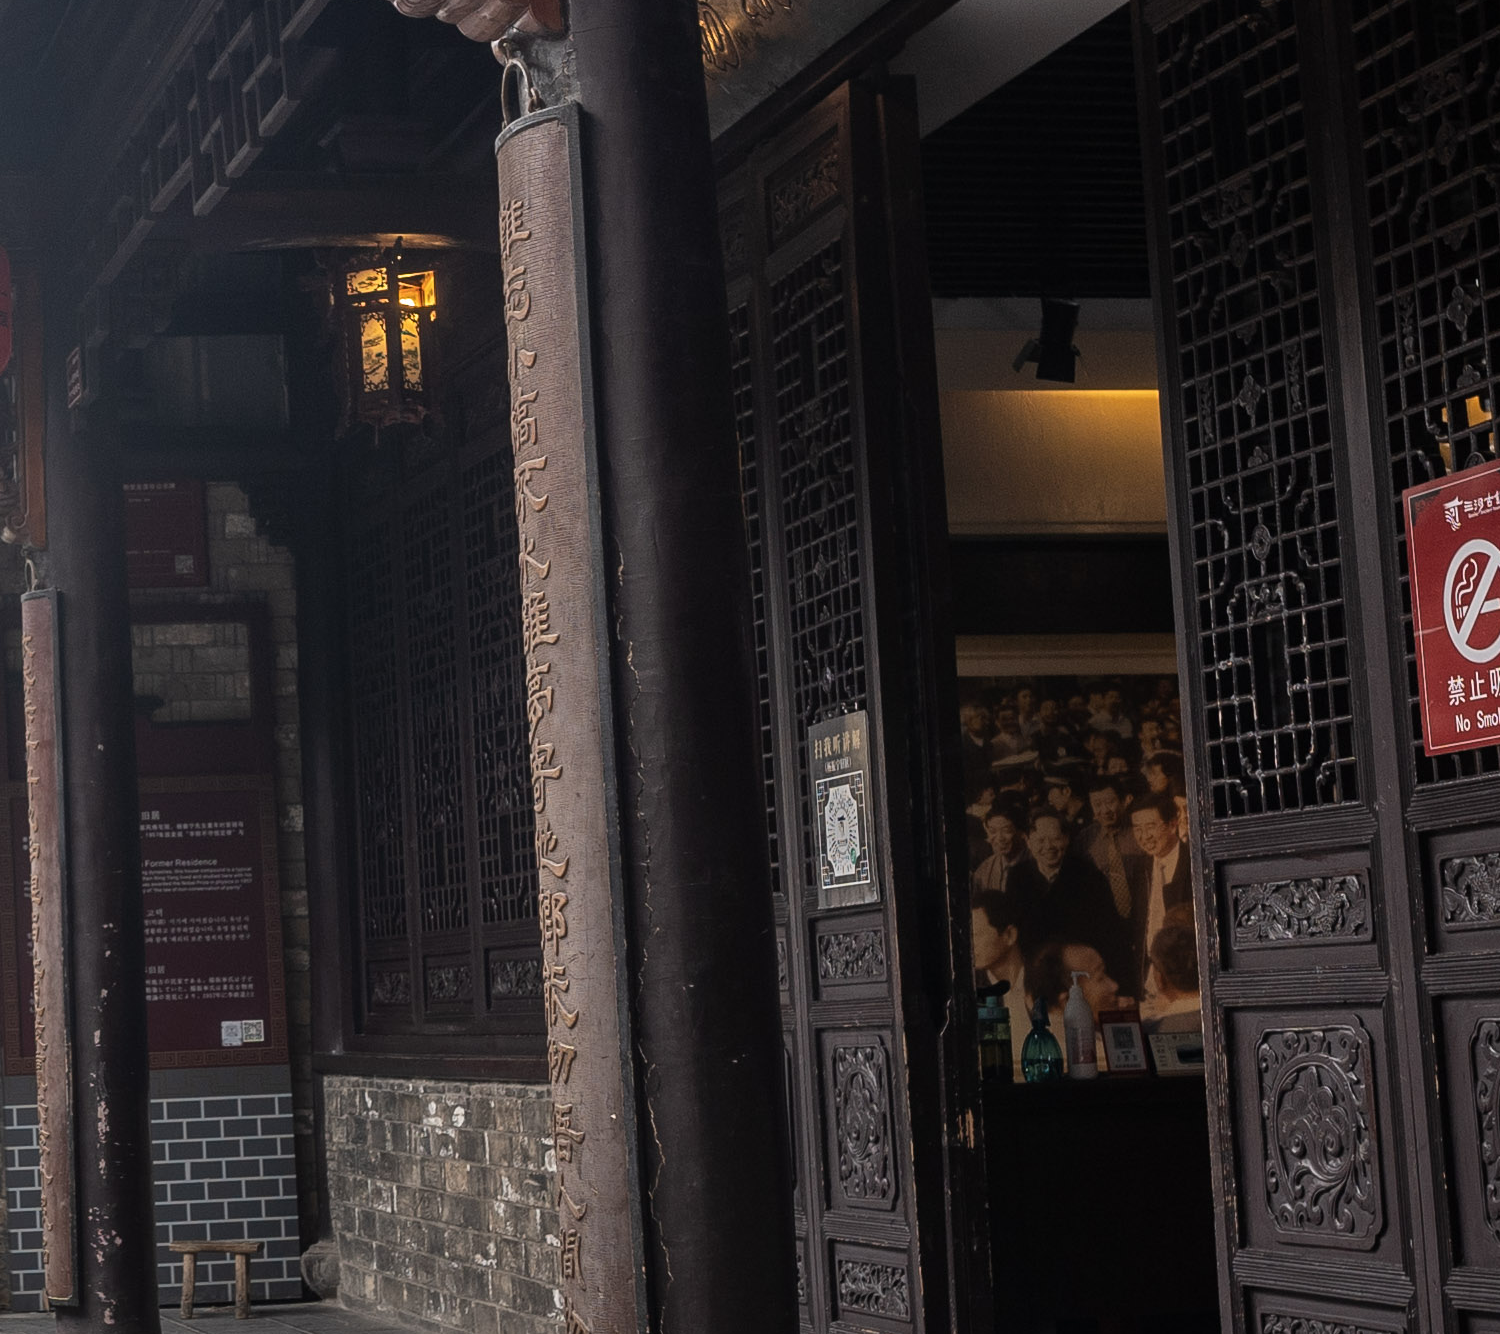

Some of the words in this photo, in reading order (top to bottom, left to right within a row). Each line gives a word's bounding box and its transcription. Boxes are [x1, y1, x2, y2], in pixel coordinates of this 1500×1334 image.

[1455, 714, 1471, 733] No
[144, 859, 173, 867] Former
[175, 858, 218, 867] Residence
